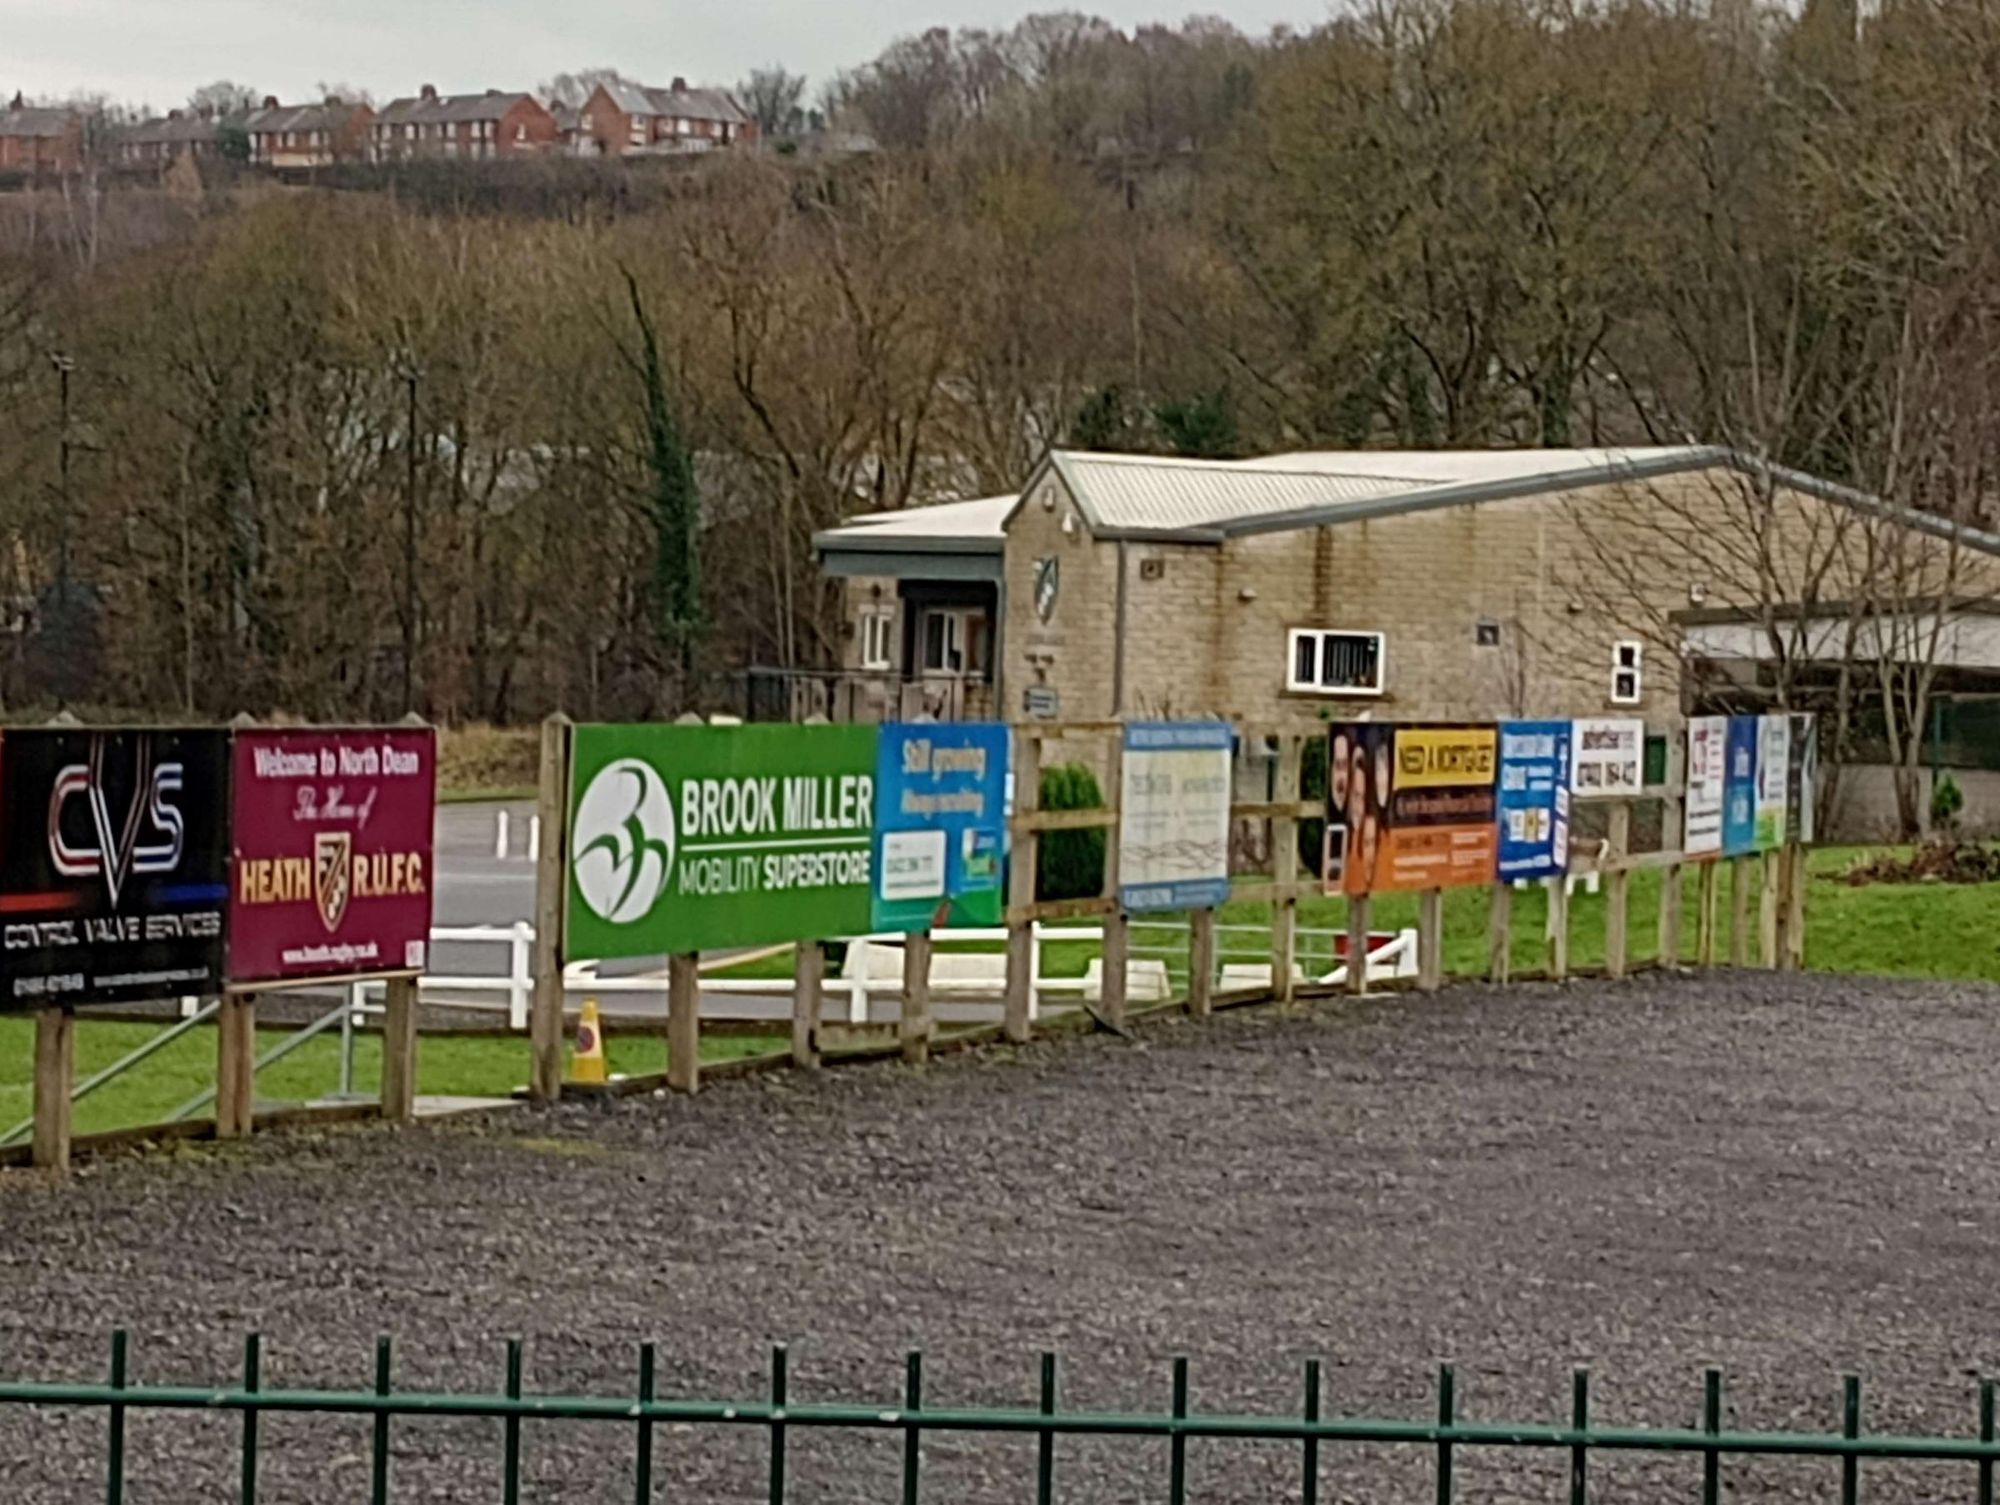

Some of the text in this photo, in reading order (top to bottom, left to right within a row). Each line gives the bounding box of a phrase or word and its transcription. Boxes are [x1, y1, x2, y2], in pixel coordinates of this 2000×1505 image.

[254, 745, 419, 777] Welcome to North Dean
[48, 735, 184, 908] CVS
[293, 784, 378, 830] The Home of
[682, 775, 873, 836] BROOK MILLER
[240, 852, 425, 904] HEATH R.U.F.C.
[679, 855, 761, 896] MOBILITY
[763, 850, 871, 890] SUPERSTORE
[4, 911, 221, 949] CONTROL VALVE SERVICES
